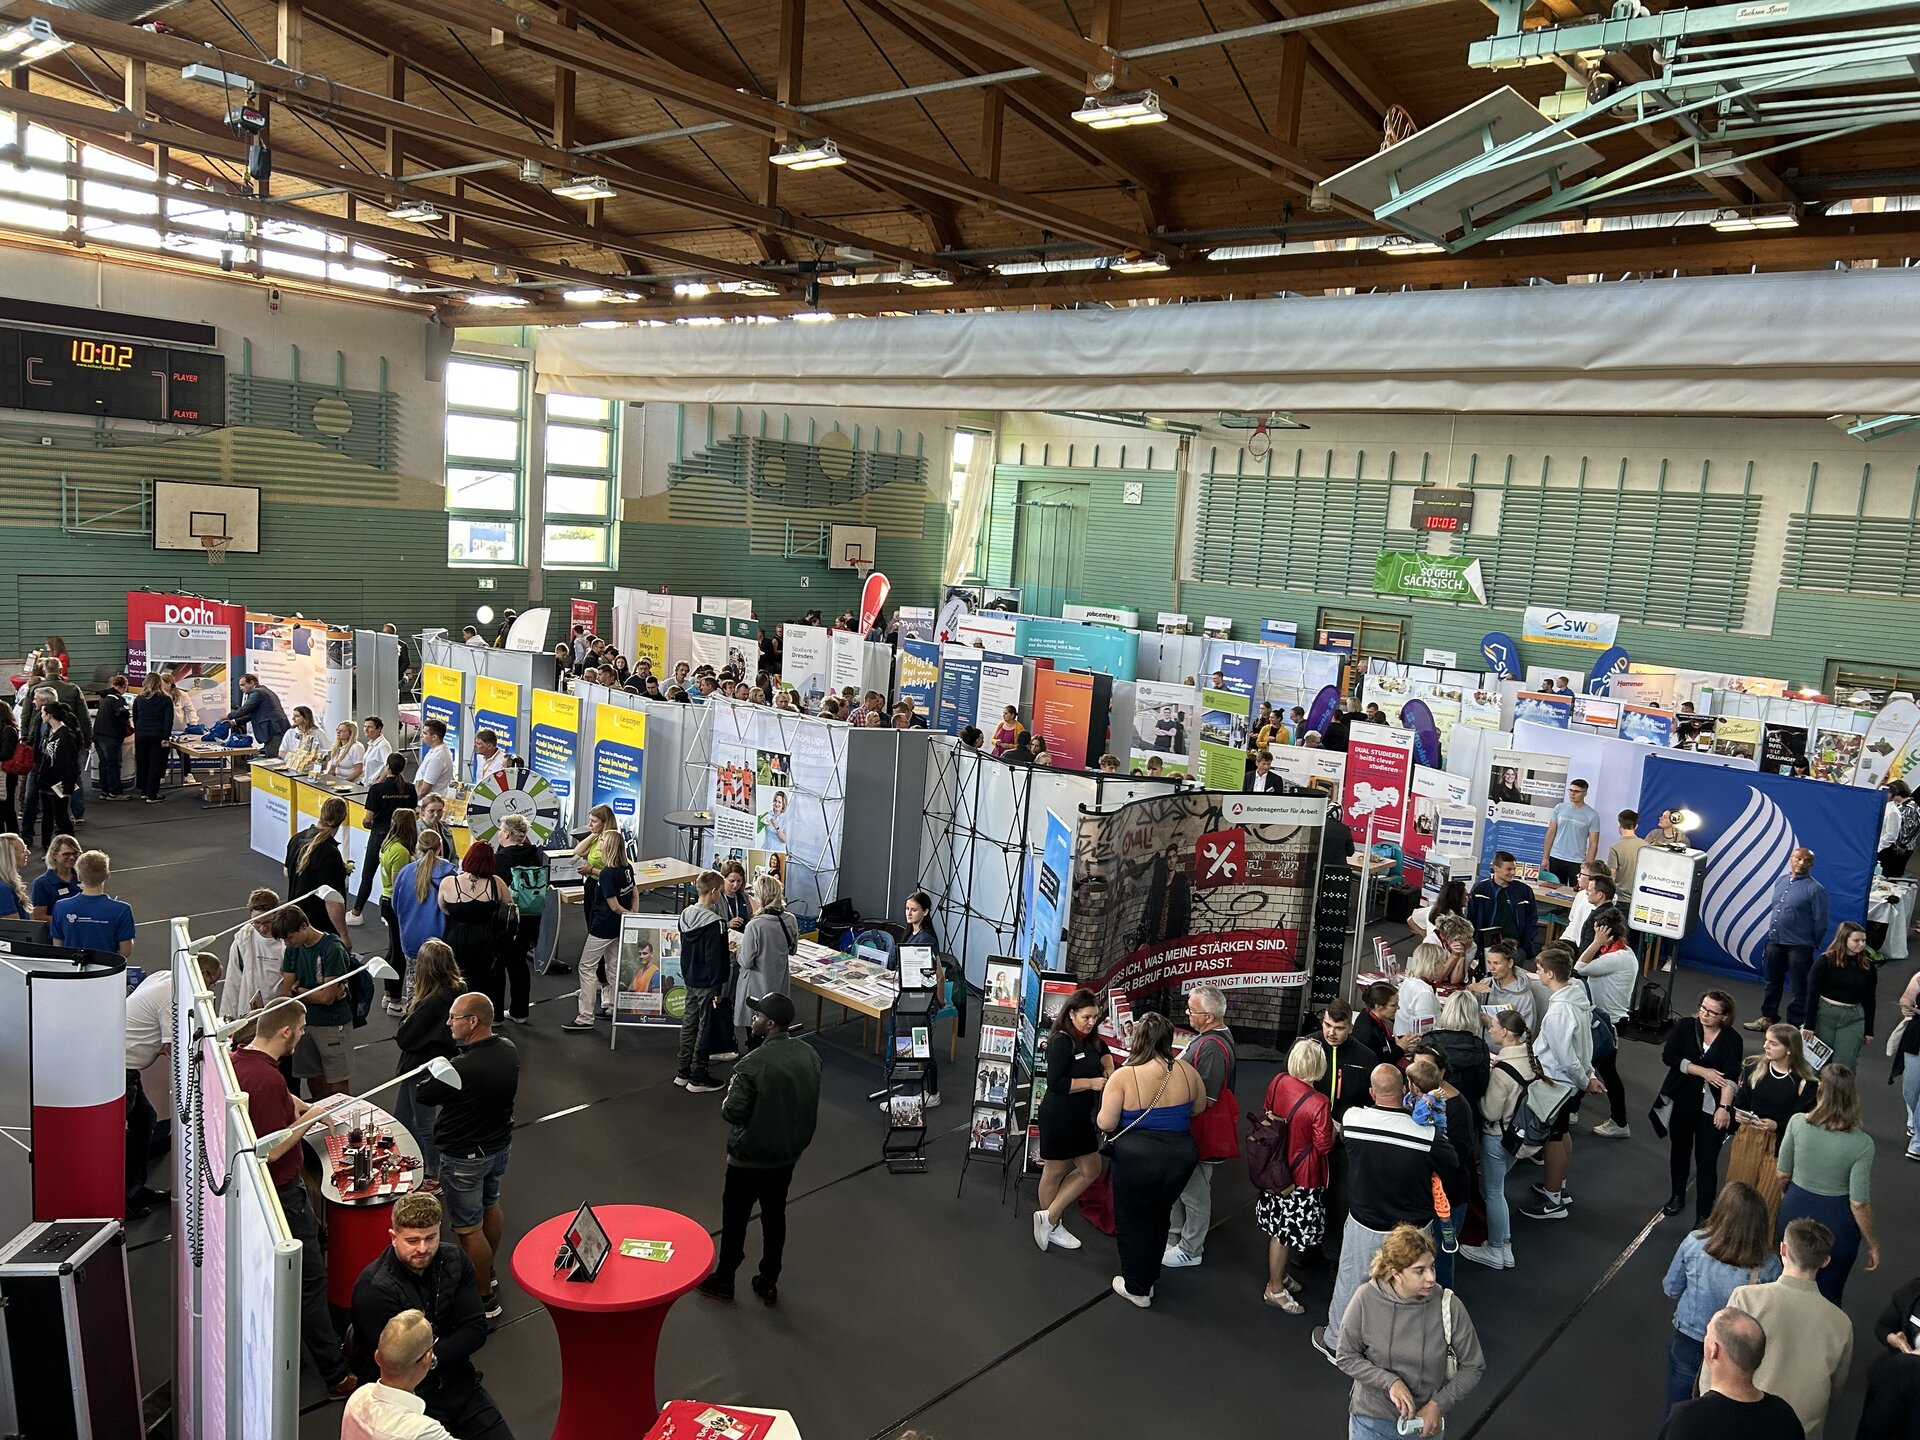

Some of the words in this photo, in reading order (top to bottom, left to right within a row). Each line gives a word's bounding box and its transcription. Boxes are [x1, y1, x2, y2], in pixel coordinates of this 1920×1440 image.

[72, 340, 133, 368] 10:02
[173, 373, 198, 382] PLAYER
[173, 410, 198, 419] PLAYER
[1427, 516, 1458, 529] 10:02
[1421, 567, 1433, 577] SO
[1434, 568, 1458, 579] GEHT
[802, 577, 808, 586] K
[1404, 573, 1465, 590] SÄCHSISCH.
[165, 601, 214, 625] porta
[1563, 620, 1598, 633] SWD
[128, 648, 147, 657] Richt
[128, 659, 142, 667] Job
[903, 654, 934, 669] SCHÜLER
[902, 667, 916, 677] UNI
[903, 678, 935, 690] VERSITÄT
[1617, 680, 1644, 688] Hammer
[555, 701, 575, 711] Leipziger
[620, 714, 641, 726] Leipziger
[1354, 746, 1370, 755] DUAL
[1370, 747, 1404, 760] STUDIEREN
[1359, 754, 1376, 762] heißt
[1376, 757, 1395, 765] clever
[1196, 749, 1208, 784] Halle
[1369, 762, 1398, 773] studieren
[1501, 807, 1516, 815] Gute
[1517, 808, 1536, 819] Gründe
[1647, 875, 1685, 887] DANPOWER
[1125, 961, 1143, 976] ICH,
[1144, 952, 1163, 969] WAS
[1165, 945, 1197, 962] MEINE
[1199, 939, 1253, 955] STÄRKEN
[1255, 939, 1288, 951] SIND.
[1132, 971, 1162, 990] BERUF
[1163, 961, 1192, 978] DAZU
[1194, 957, 1233, 972] PASST.
[1242, 975, 1268, 984] MICH
